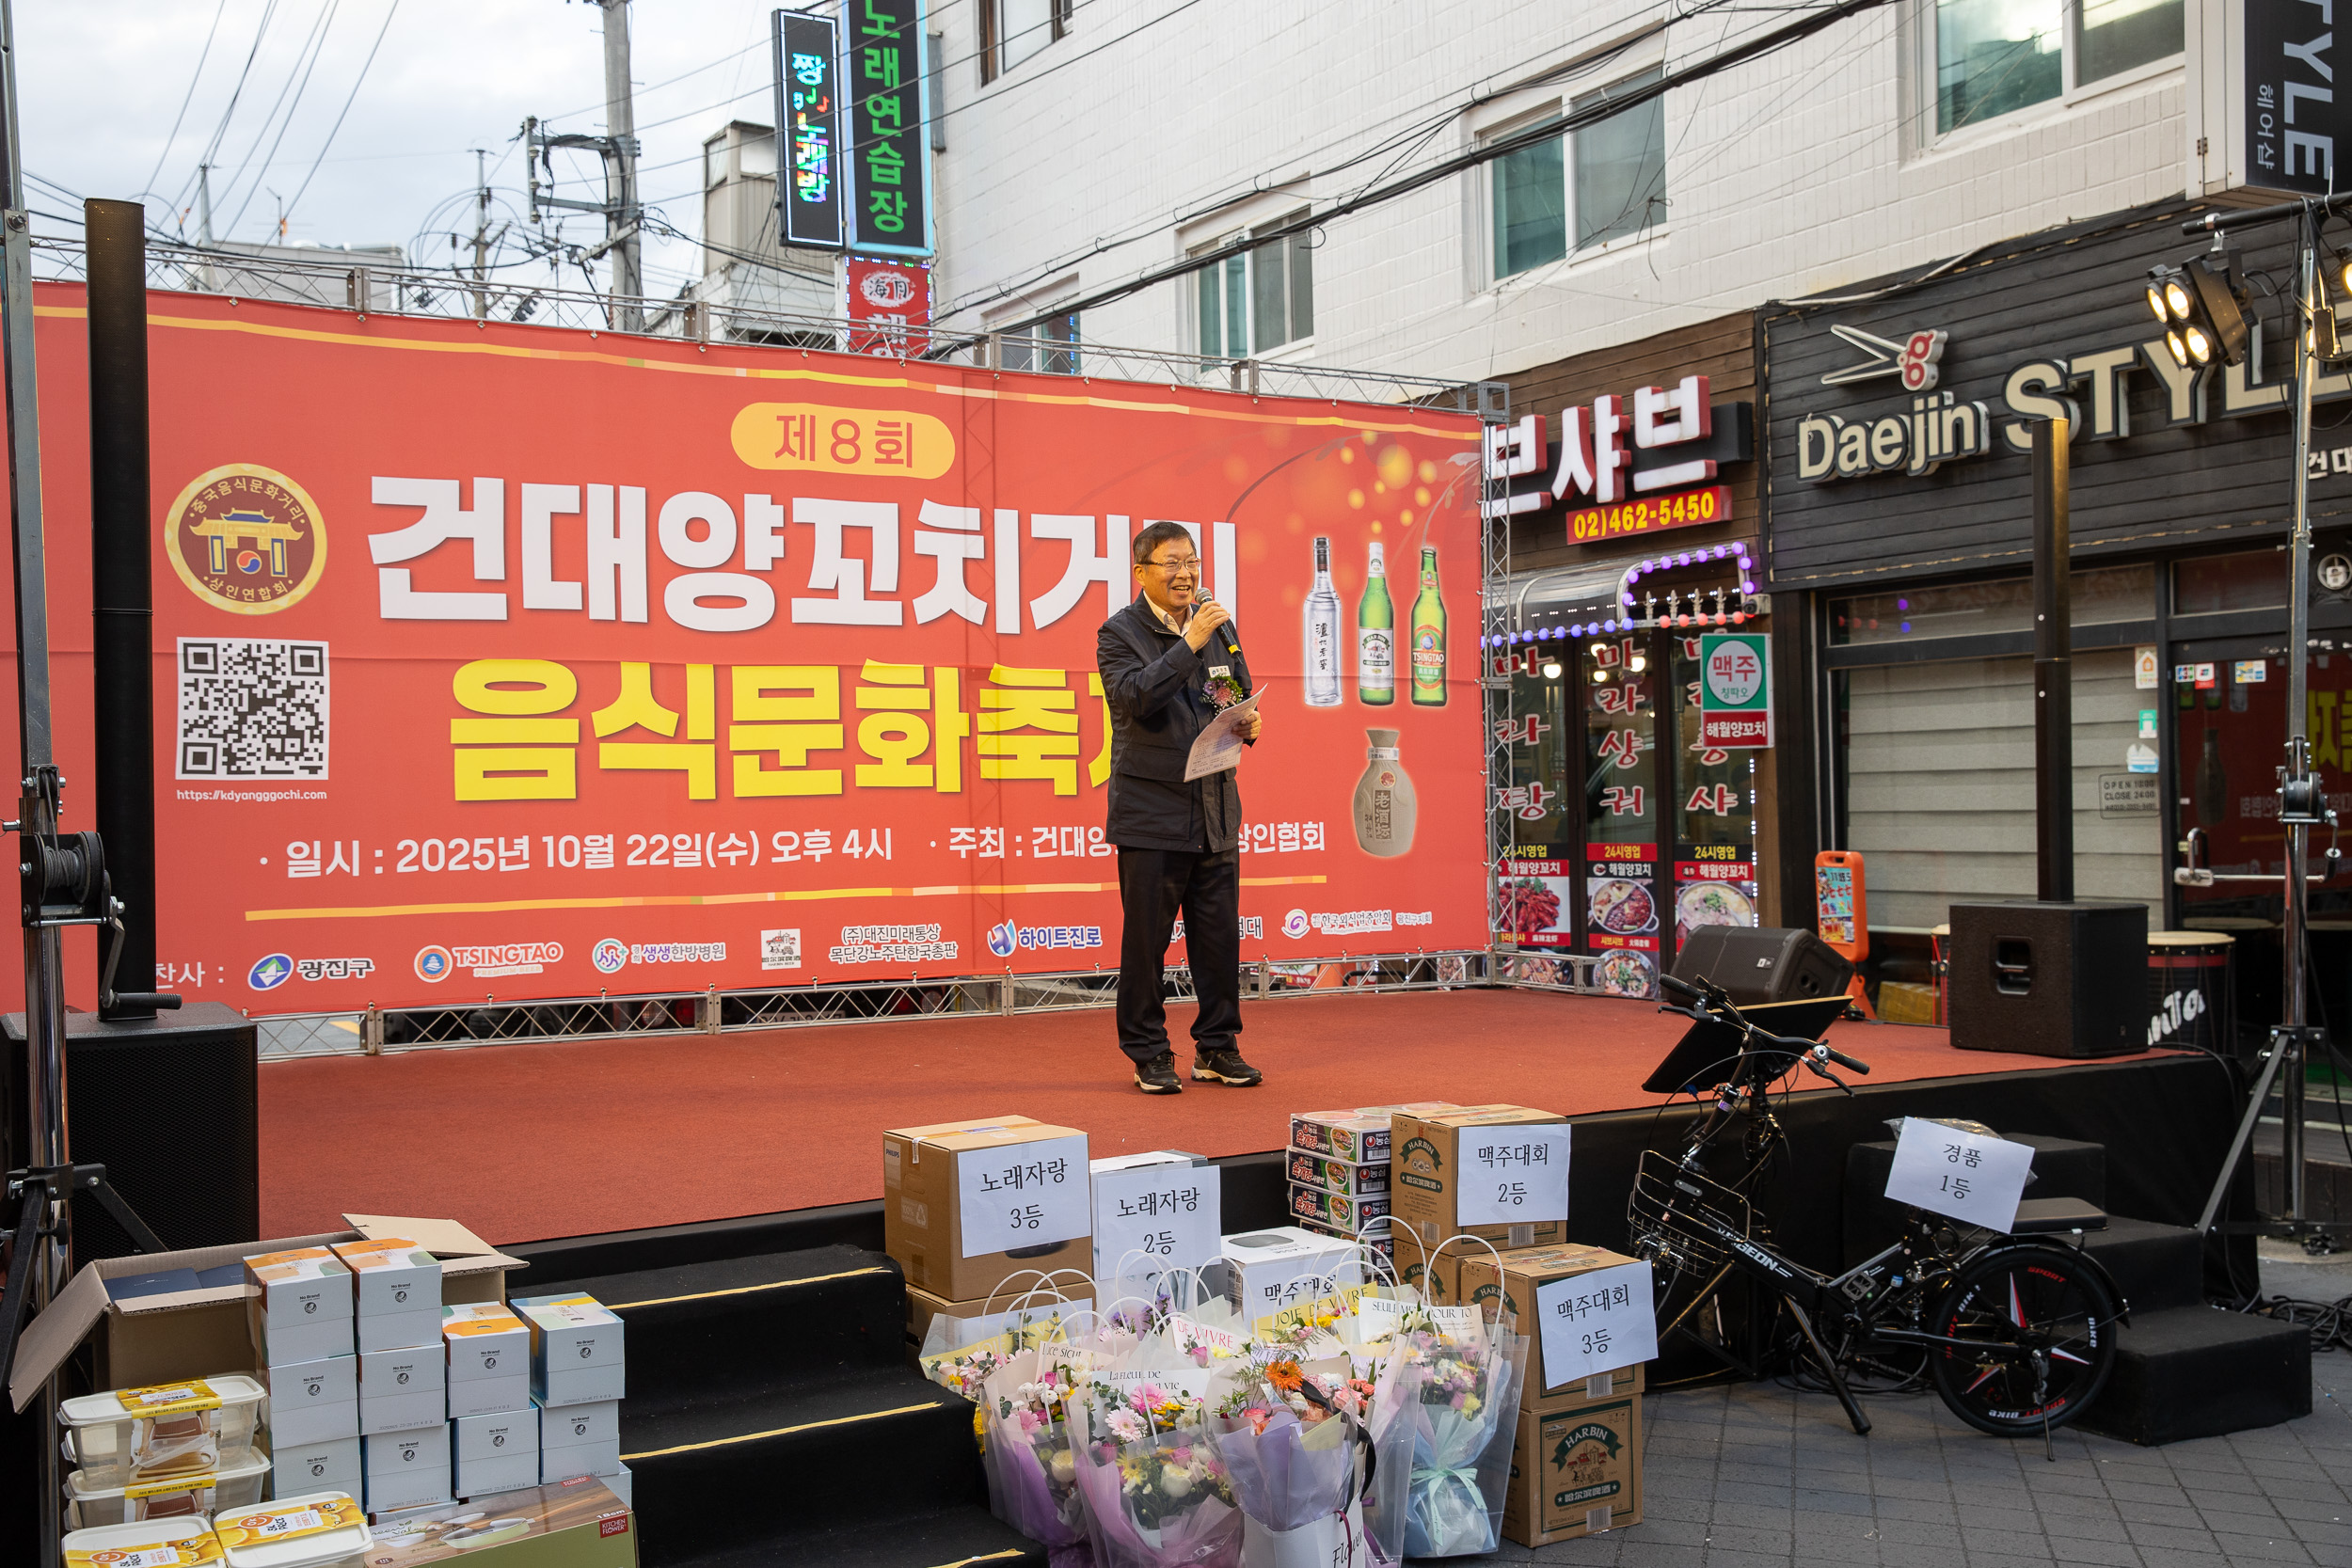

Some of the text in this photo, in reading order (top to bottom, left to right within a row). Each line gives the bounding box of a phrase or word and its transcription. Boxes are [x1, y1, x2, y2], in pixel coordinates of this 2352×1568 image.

[862, 0, 908, 233] 노래연습장
[772, 413, 915, 468] 제8회
[1797, 394, 1977, 480] Daejin
[190, 477, 305, 520] 중국음식문화거리
[1573, 491, 1715, 539] 02)462-5450
[209, 578, 288, 602] 상인연합회
[1412, 652, 1445, 663] TSINGTAO
[1712, 655, 1756, 683] 맥주
[1721, 688, 1749, 700] 칭따오
[450, 658, 1111, 802] 음식문화축
[1706, 721, 1767, 738] 해월양꼬치
[176, 788, 327, 803] https://kdyangggochi.com
[286, 827, 892, 878] 일시 2025년 10월 22일(수) 오후 4시
[948, 826, 1005, 859] 주최
[1604, 845, 1642, 859] 24시영업
[1694, 846, 1736, 860] 24시영업
[1609, 863, 1653, 877] 해월양꼬치
[1699, 863, 1749, 879] 해월양꼬치
[842, 925, 941, 943] (주)대진미래통상
[1018, 926, 1103, 950] 하이트진로
[453, 942, 562, 966] TSINGTAO
[643, 943, 726, 963] 생생한방병원
[830, 942, 958, 963] 목단강노주탄한국총판
[297, 959, 373, 979] 광진구
[475, 965, 543, 977] PREMIUM BEER
[1295, 1129, 1318, 1149] 육개장
[1407, 1139, 1435, 1155] HARBIN
[885, 1148, 900, 1159] PHILIPS
[1477, 1143, 1549, 1169] 맥주대회
[1943, 1143, 1982, 1168] 경품
[979, 1158, 1069, 1193] 노래자랑
[1498, 1181, 1528, 1205] 2등
[1939, 1174, 1971, 1199] 1등
[1116, 1186, 1201, 1217] 노래자랑
[1009, 1204, 1044, 1229] 3등
[1143, 1230, 1177, 1255] 2등
[1410, 1266, 1438, 1283] HARIN
[2027, 1266, 2067, 1283] SPORT
[1557, 1284, 1630, 1323] 맥주대회
[1276, 1308, 1302, 1328] JOIE
[1177, 1320, 1234, 1350] DE VIVRE
[1581, 1328, 1613, 1354] 3등
[1988, 1409, 2020, 1419] BIKE
[2024, 1397, 2066, 1418] SPRT
[1565, 1426, 1608, 1449] HARBIN
[1565, 1483, 1612, 1503] 哈尔滨啤酒
[596, 1510, 626, 1519] 18cm
[602, 1518, 626, 1529] KITCHEN
[602, 1525, 625, 1535] FLOWER
